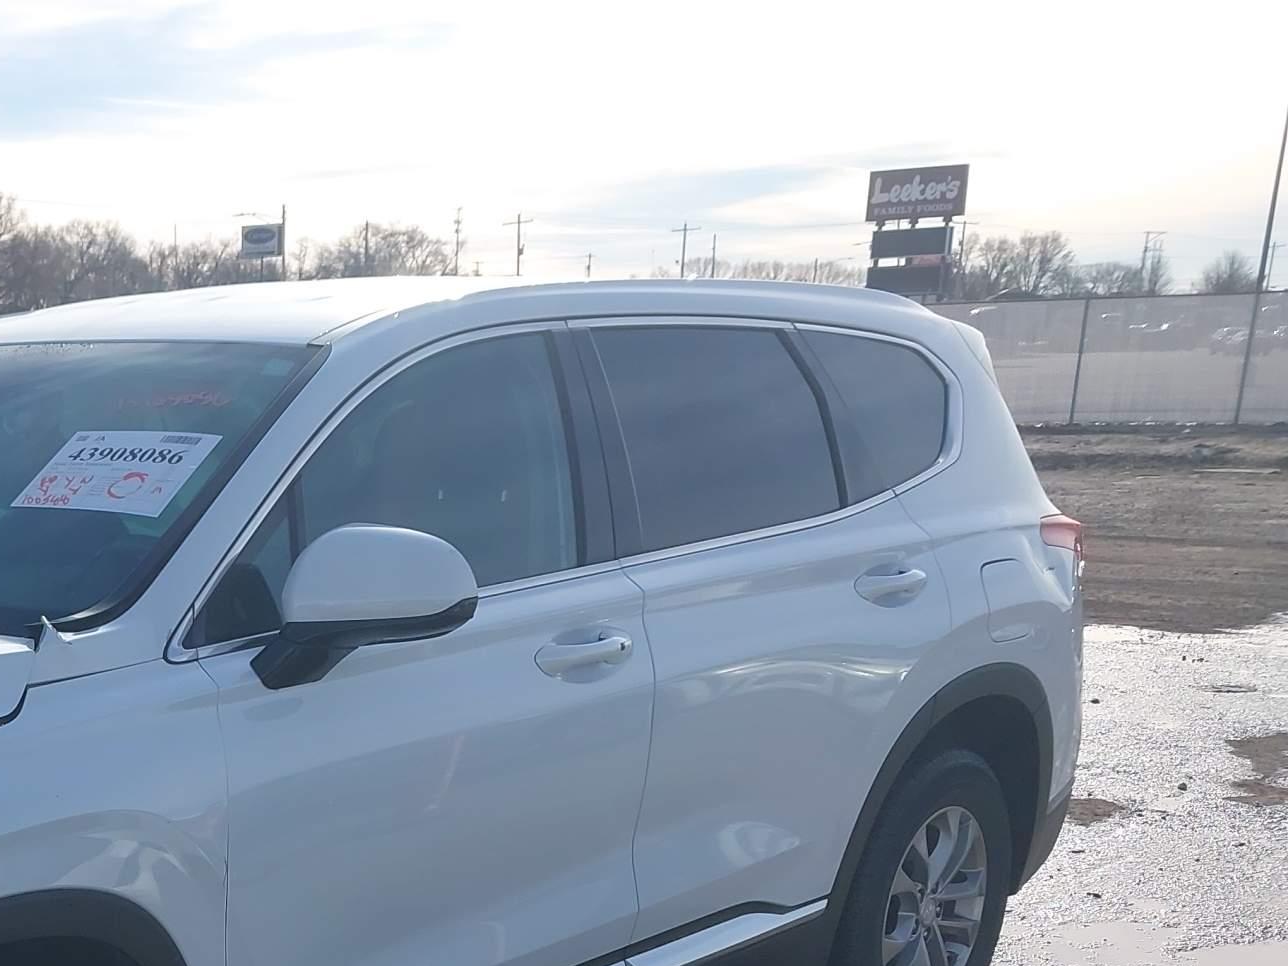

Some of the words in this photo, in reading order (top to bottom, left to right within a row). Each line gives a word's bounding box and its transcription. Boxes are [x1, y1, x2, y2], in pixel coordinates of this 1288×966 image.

[870, 174, 961, 204] Leeker's
[873, 205, 915, 217] FAMILY
[917, 202, 953, 214] FOODS
[68, 447, 189, 464] 43908086
